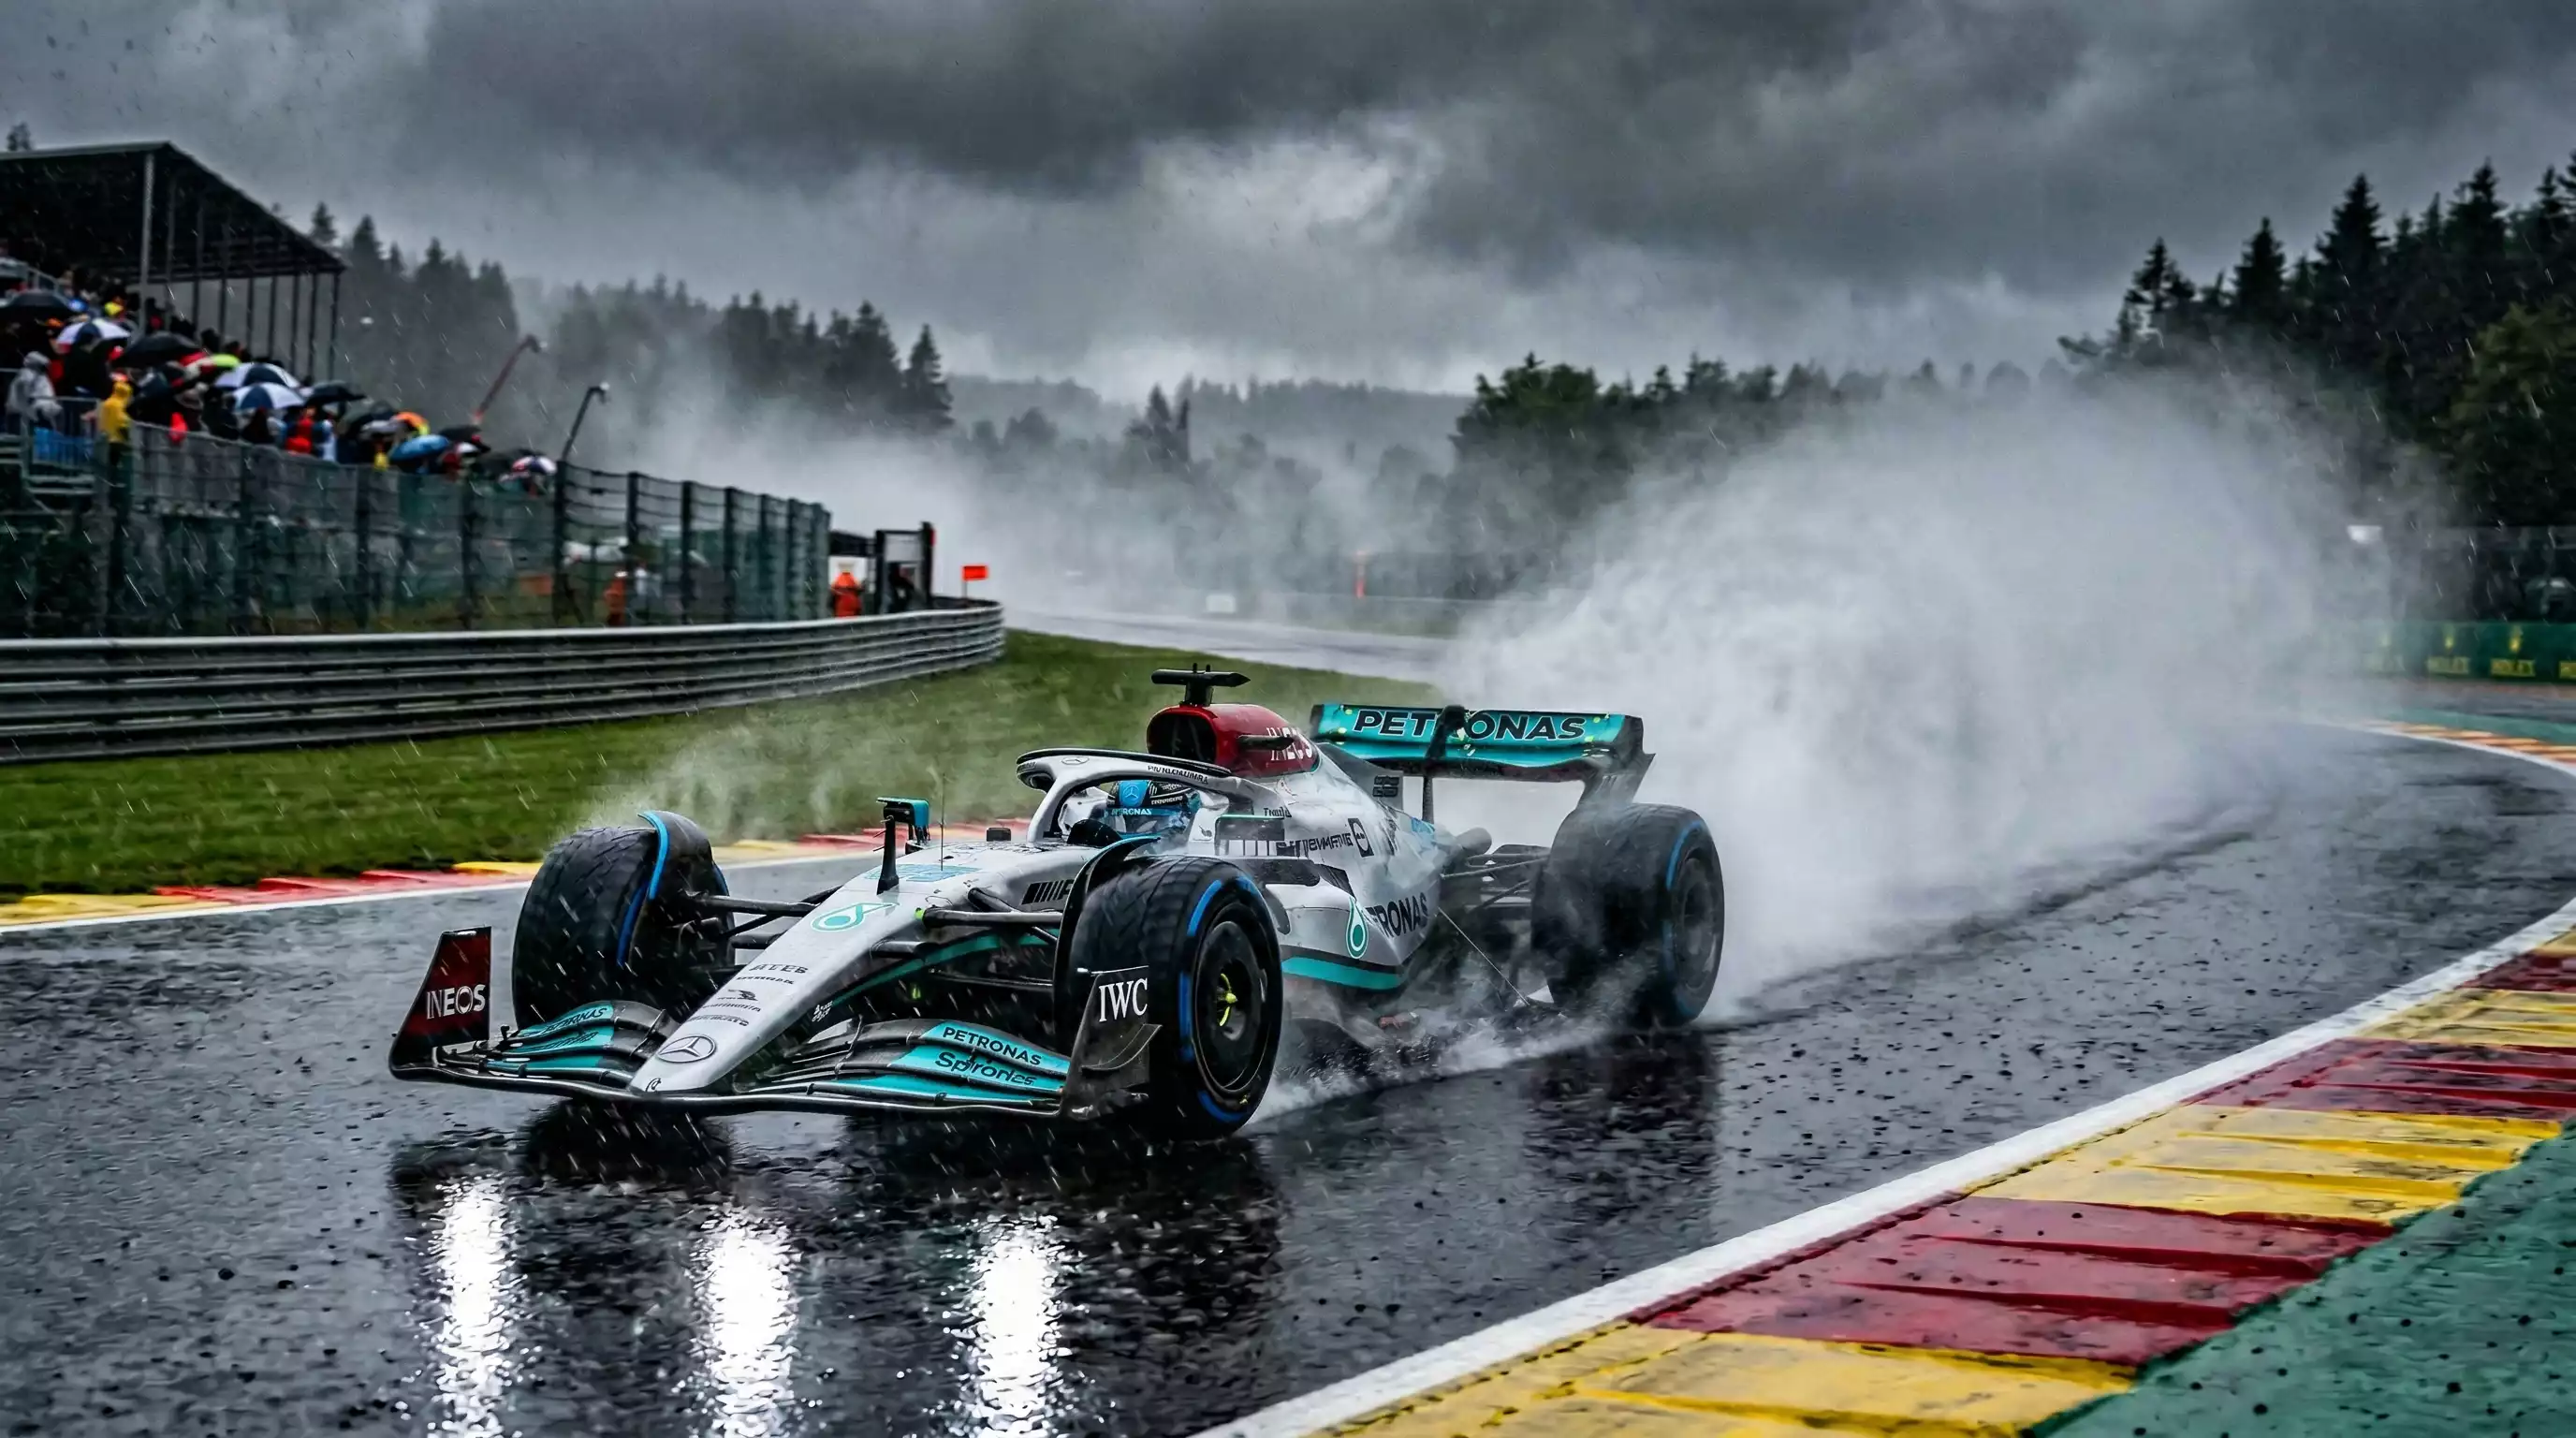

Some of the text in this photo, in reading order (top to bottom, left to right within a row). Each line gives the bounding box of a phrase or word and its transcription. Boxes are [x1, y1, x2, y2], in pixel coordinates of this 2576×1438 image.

[1354, 709, 1586, 741] PETONAS
[427, 984, 486, 1020] INEOS
[1099, 977, 1148, 1022] IWC
[943, 1027, 1042, 1065] PETRONAS
